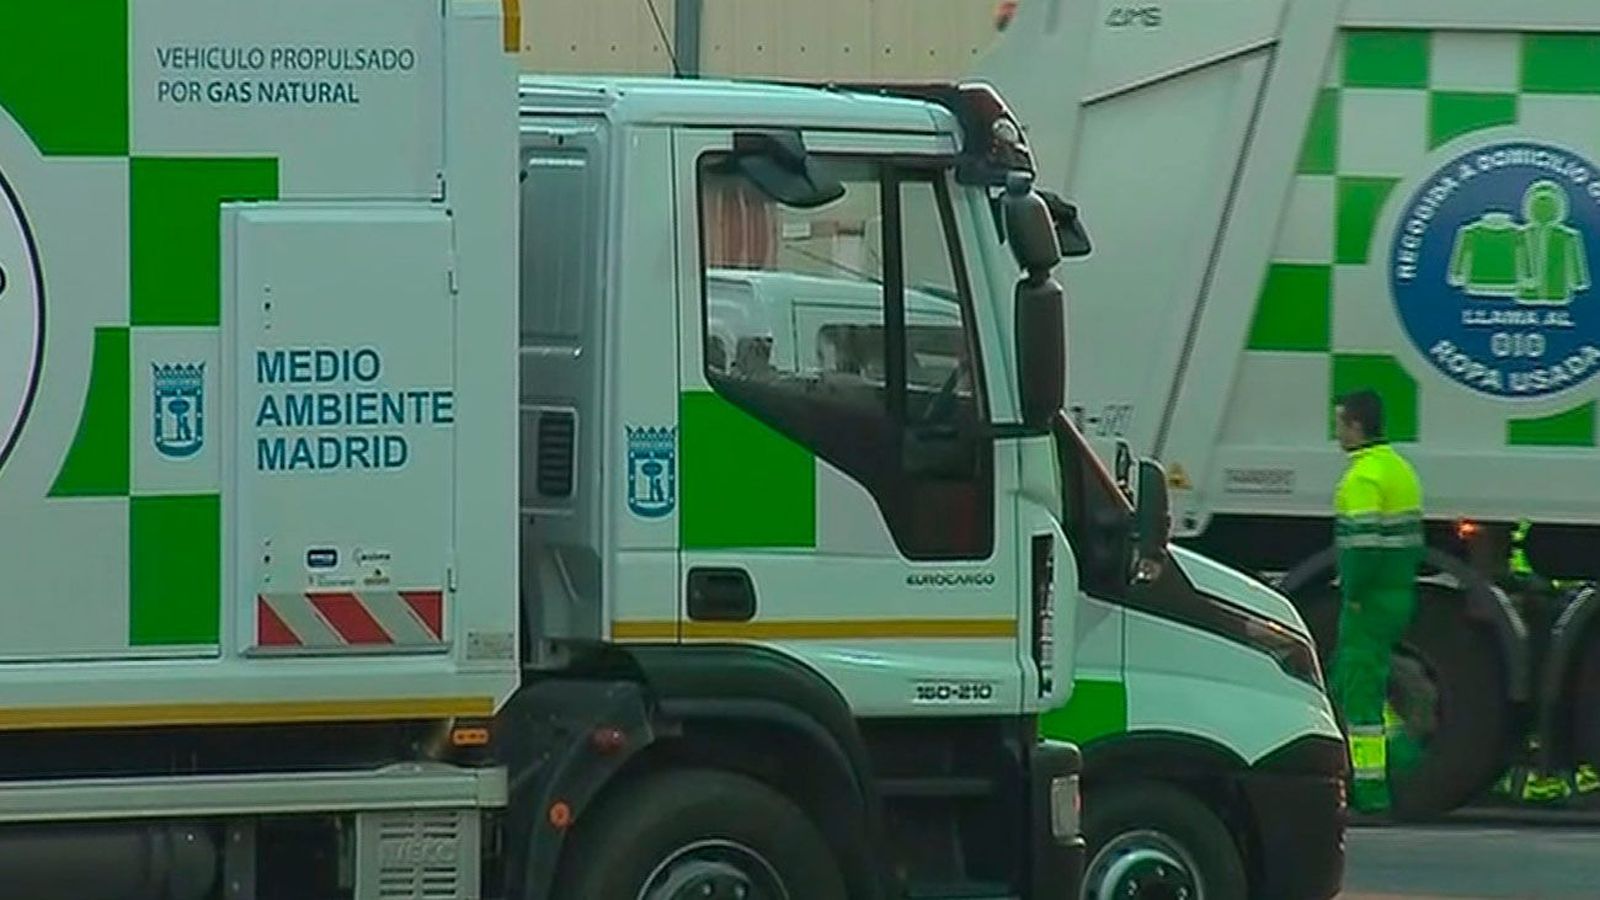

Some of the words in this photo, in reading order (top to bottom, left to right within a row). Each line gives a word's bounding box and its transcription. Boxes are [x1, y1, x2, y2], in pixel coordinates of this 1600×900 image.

[156, 48, 265, 71] VEHICULO
[270, 48, 415, 72] PROPULSADO
[157, 82, 202, 103] POR
[207, 82, 252, 104] GAS
[258, 82, 360, 103] NATURAL
[1461, 309, 1539, 325] LLAMA
[1544, 309, 1575, 326] AL
[1490, 332, 1546, 358] 010
[256, 349, 381, 383] MEDIO
[1429, 338, 1503, 391] ROPA
[1508, 345, 1600, 392] USADA
[256, 391, 455, 427] AMBIENTE
[257, 435, 409, 471] MADRID
[906, 573, 996, 586] EUROCARGO
